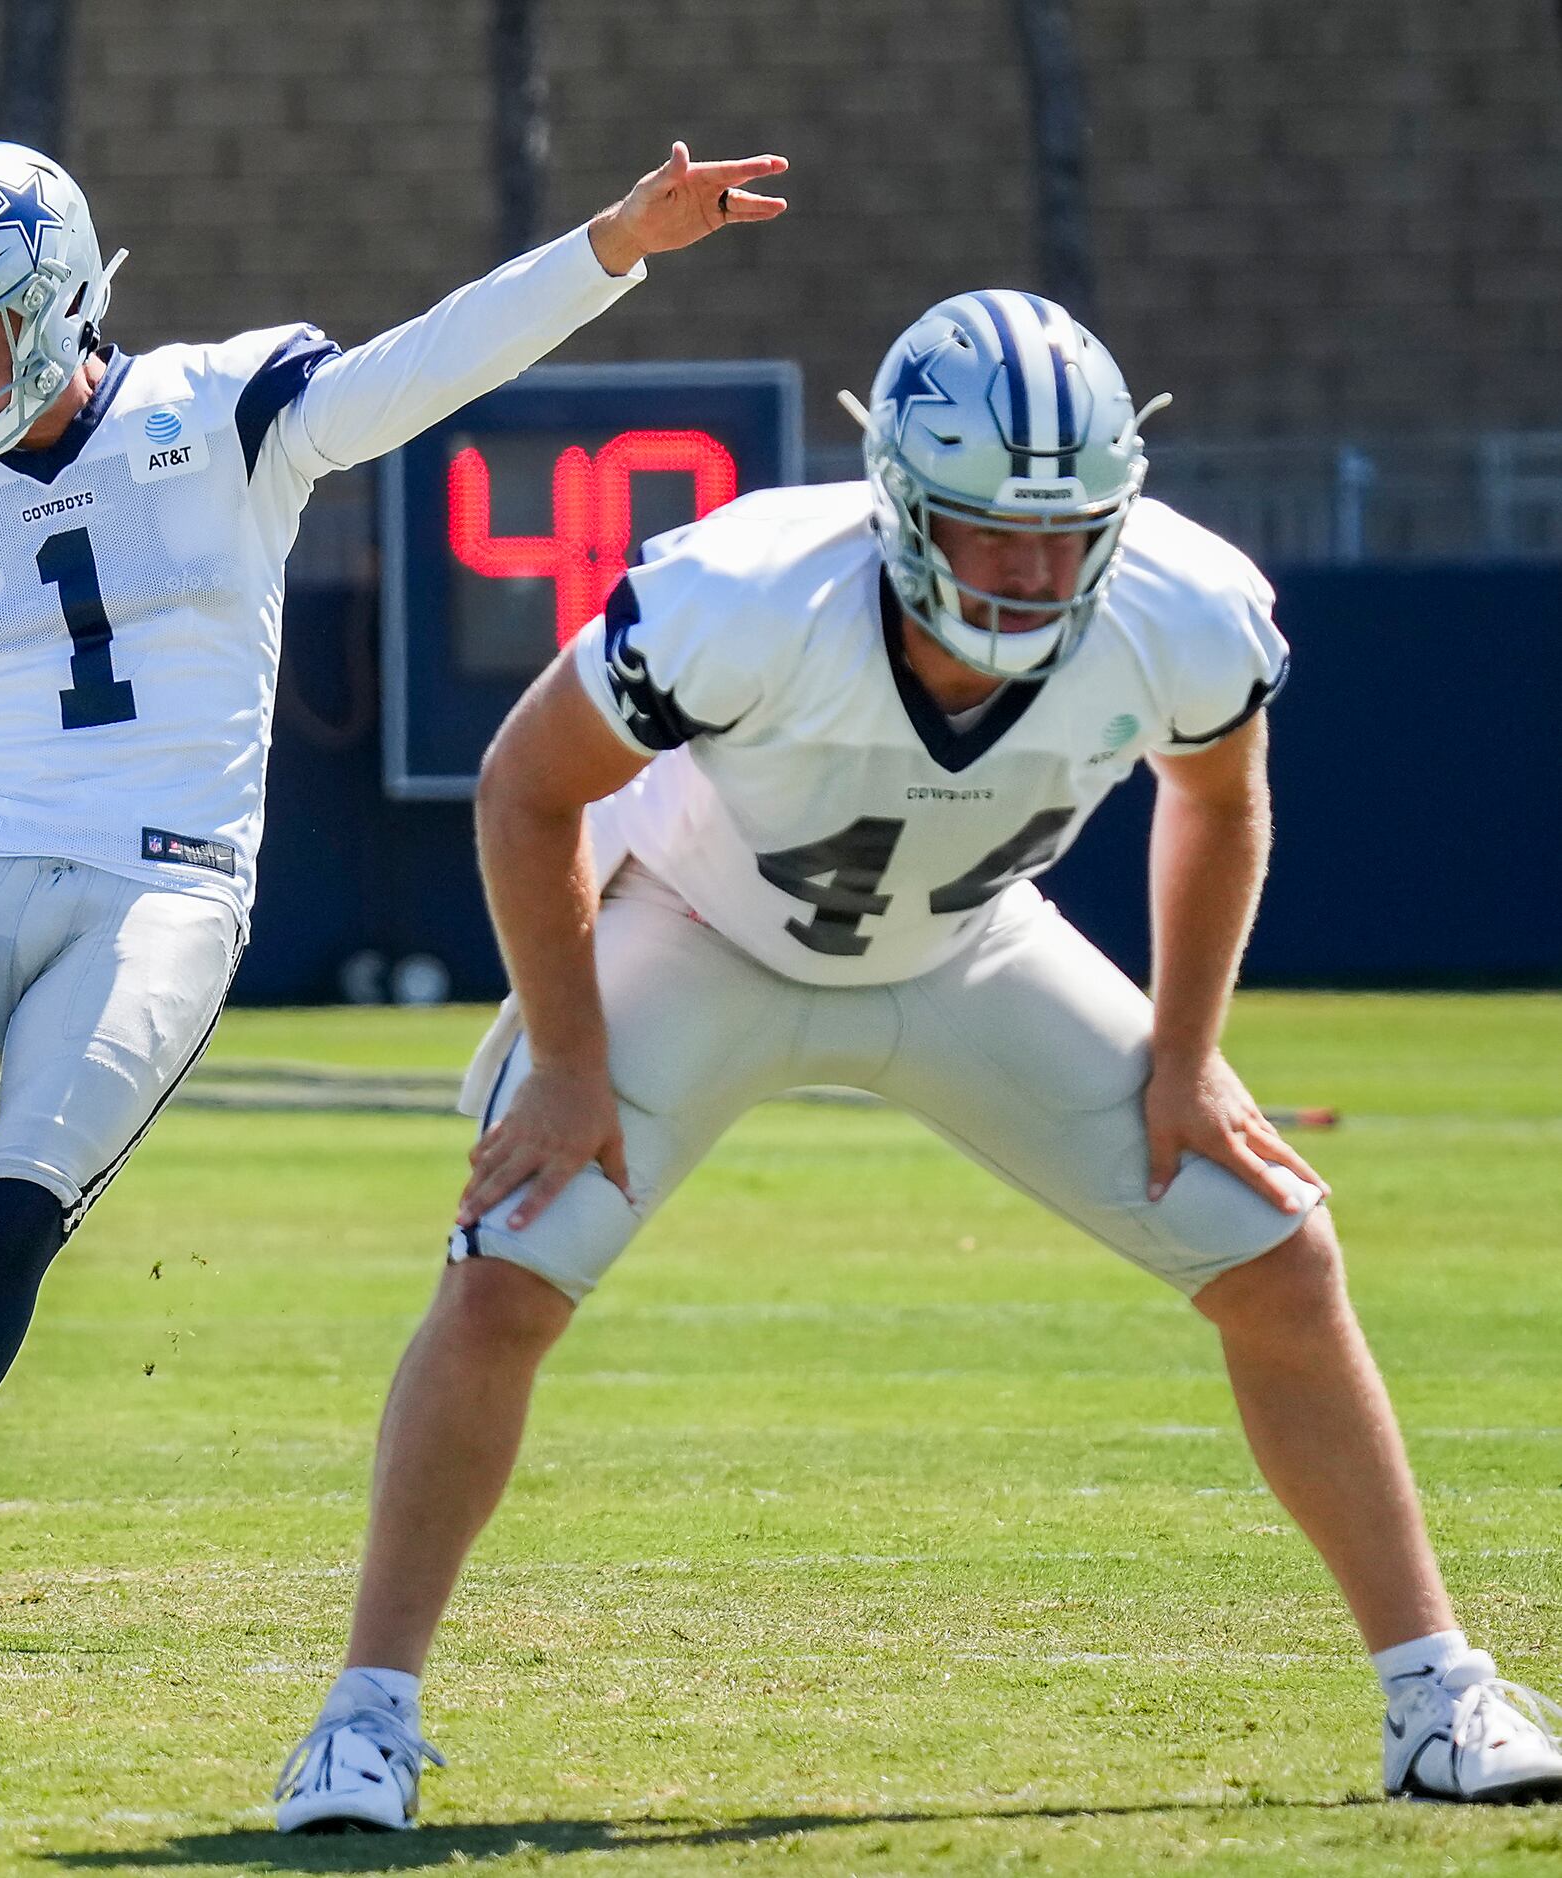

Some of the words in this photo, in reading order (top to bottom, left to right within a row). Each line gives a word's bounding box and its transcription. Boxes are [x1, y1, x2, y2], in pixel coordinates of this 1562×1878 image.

[148, 446, 193, 471] AT&T
[22, 491, 94, 523] COWBOYS
[35, 526, 137, 730] 1
